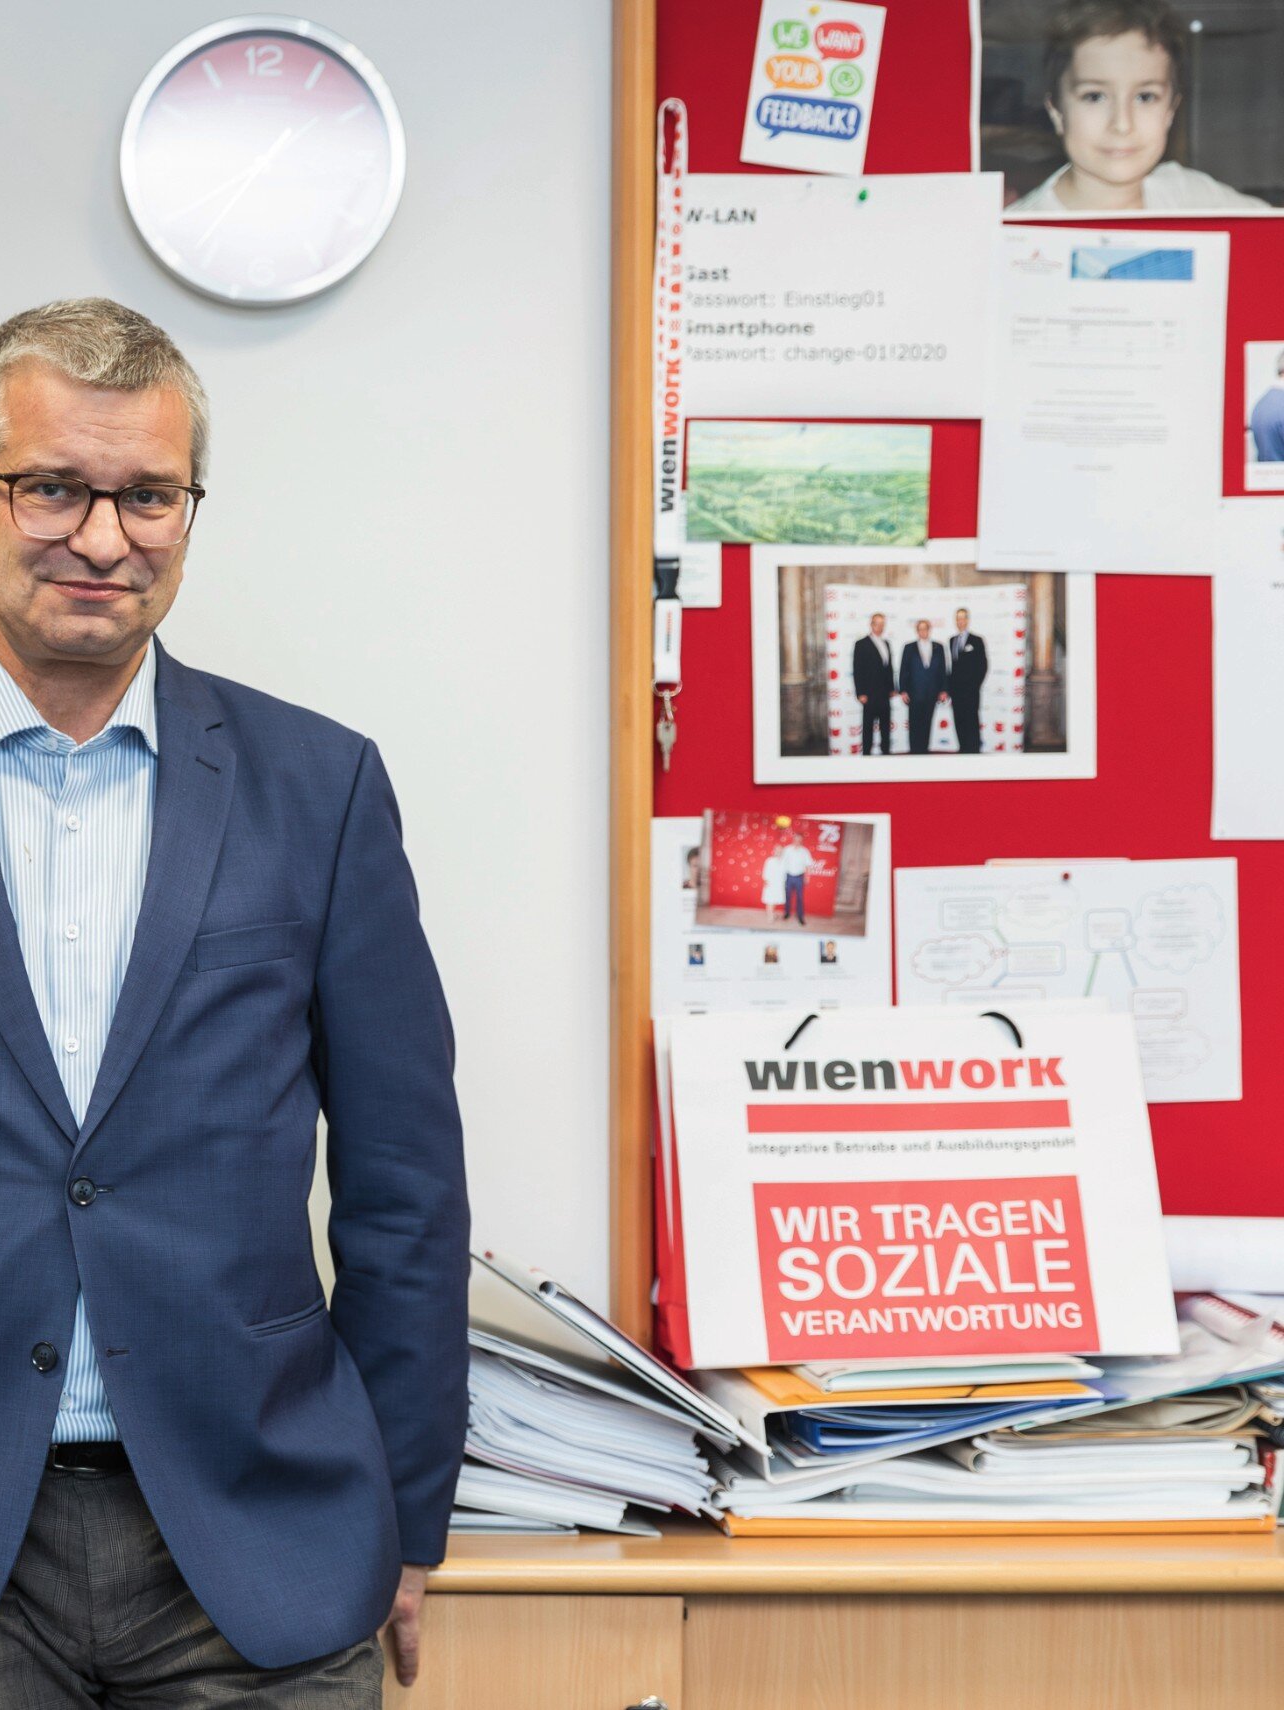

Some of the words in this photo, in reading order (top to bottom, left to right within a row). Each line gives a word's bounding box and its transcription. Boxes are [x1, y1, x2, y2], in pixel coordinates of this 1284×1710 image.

[776, 22, 804, 45] WE
[816, 27, 862, 52] WANT
[244, 45, 284, 76] 12
[769, 58, 819, 83] YOUR
[760, 97, 857, 136] FEEDBACK!
[783, 290, 885, 310] Einstieg01
[659, 358, 681, 513] wienwork
[745, 1056, 1067, 1091] wienwork
[748, 1140, 829, 1156] integrative
[834, 1141, 896, 1153] Betriebe
[902, 1140, 931, 1152] und
[769, 1206, 860, 1243] WIR
[870, 1198, 1066, 1239] TRAGEN
[777, 1240, 1076, 1302] SOZIALE
[780, 1302, 1083, 1337] VERANTWORTUNG
